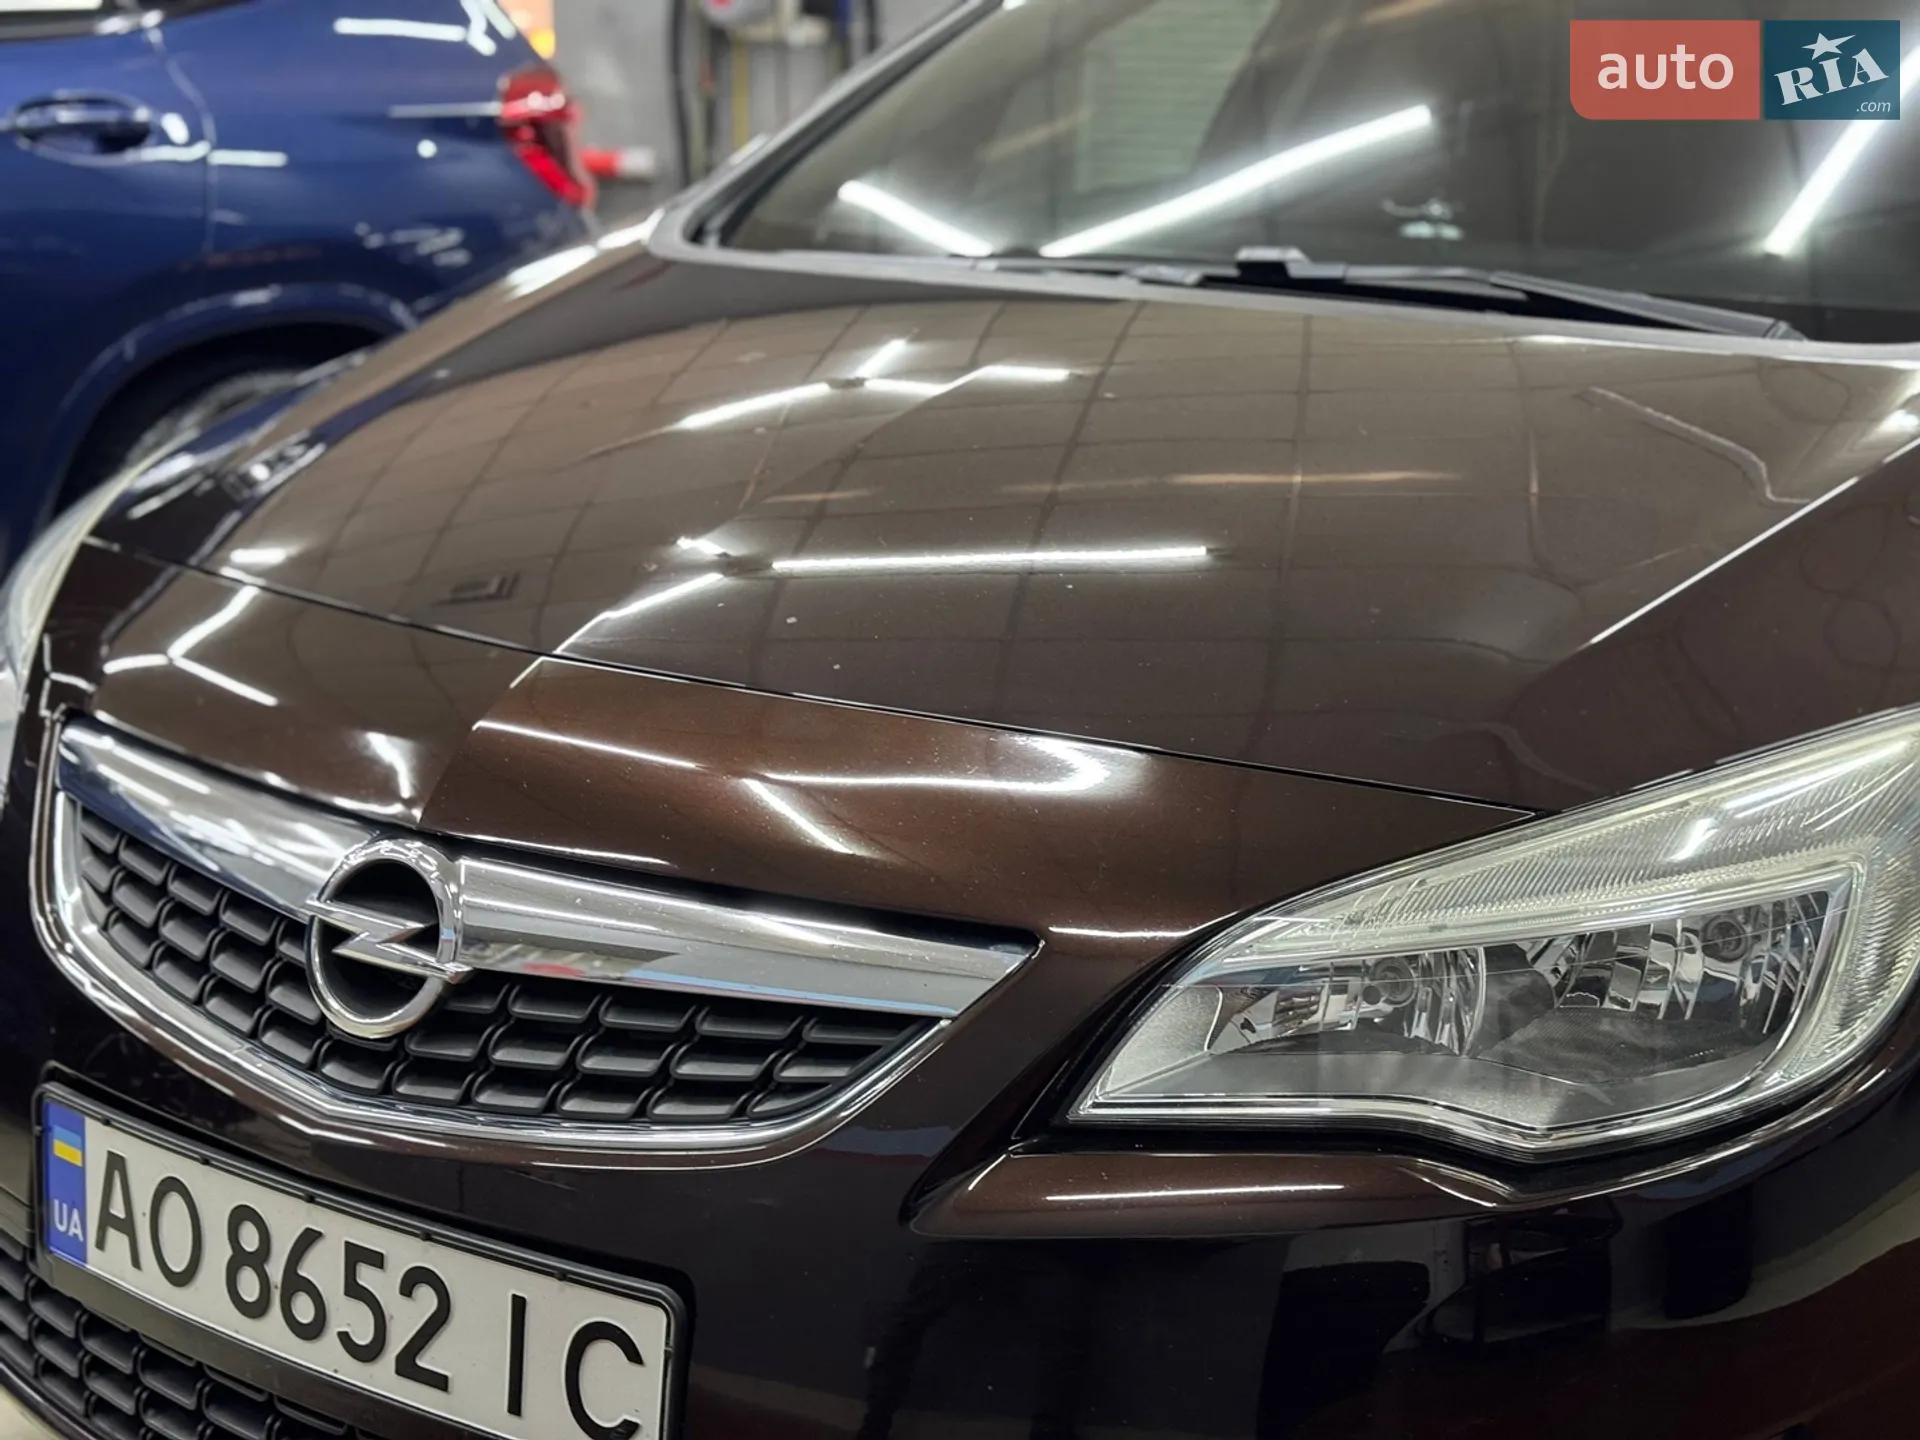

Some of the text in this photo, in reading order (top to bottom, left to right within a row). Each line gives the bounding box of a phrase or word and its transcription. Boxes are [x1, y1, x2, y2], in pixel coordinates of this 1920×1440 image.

[53, 1199, 84, 1242] UA
[95, 1150, 644, 1440] AO 8652 IC
